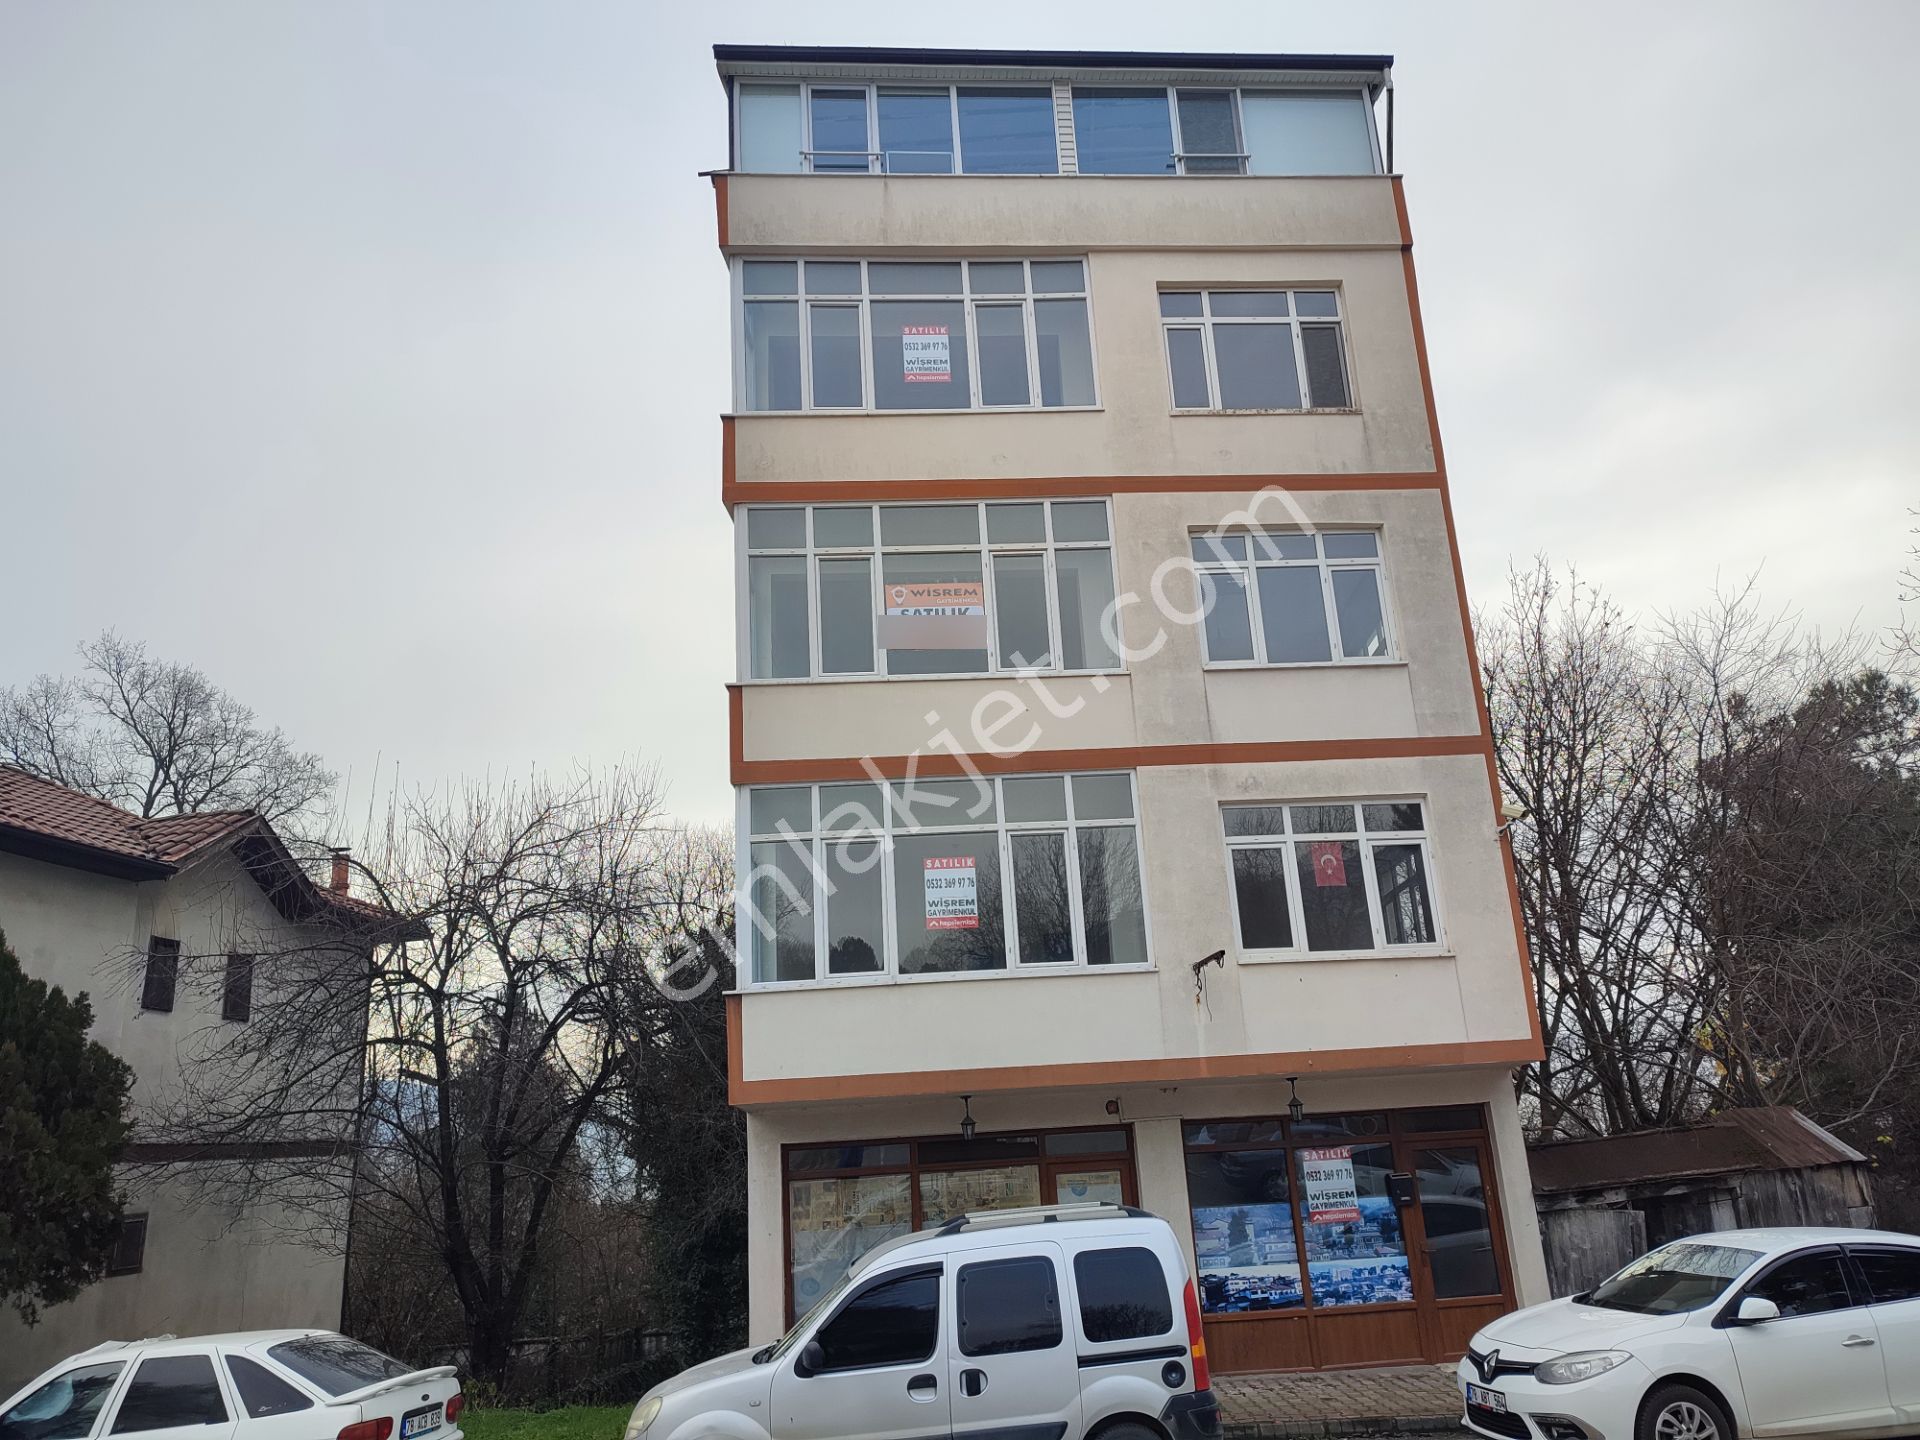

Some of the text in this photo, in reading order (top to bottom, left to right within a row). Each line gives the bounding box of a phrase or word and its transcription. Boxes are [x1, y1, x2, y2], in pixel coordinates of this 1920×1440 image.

[904, 342, 919, 351] 0532
[932, 342, 940, 351] 97
[926, 858, 975, 869] SATILIK
[926, 877, 975, 890] 0532 369 97 76
[1304, 1148, 1349, 1160] SATILIK
[1306, 1168, 1353, 1182] 0532 369 97 76
